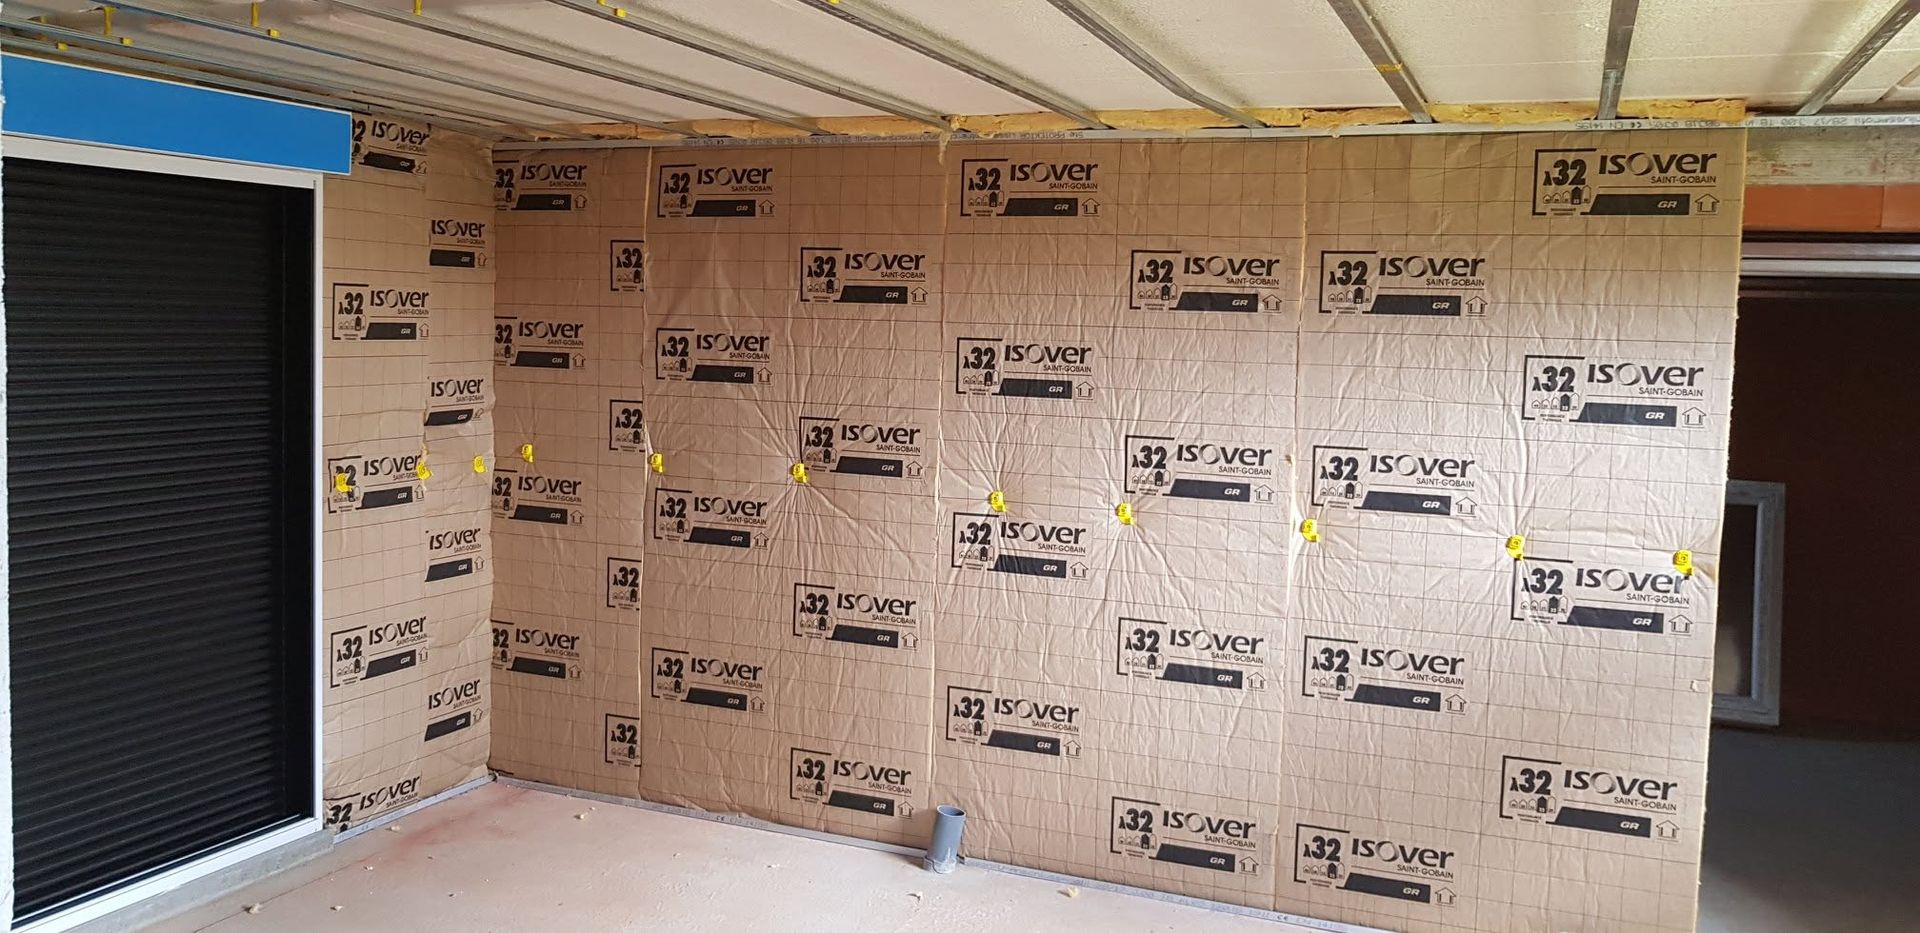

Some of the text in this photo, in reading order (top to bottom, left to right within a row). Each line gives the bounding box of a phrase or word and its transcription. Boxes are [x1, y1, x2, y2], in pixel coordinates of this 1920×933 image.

[495, 168, 514, 188] 32
[1651, 175, 1716, 184] SAINT-GOBAIN
[1657, 200, 1677, 208] GR
[1227, 277, 1279, 285] SAINT-GOBAIN
[1426, 278, 1485, 286] SAINT-GOBAIN
[1432, 302, 1449, 310] GR
[1043, 365, 1091, 373] SAINT-GOBAIN
[1639, 387, 1703, 397] SAINT-GOBAIN
[1645, 411, 1664, 420] GR
[877, 445, 920, 453] SAINT-GOBAIN
[1219, 466, 1271, 475] SAINT-GOBAIN
[1417, 477, 1475, 487] SAINT-GOBAIN
[1422, 501, 1440, 509] GR
[1038, 543, 1085, 553] SAINT-GOBAIN
[1626, 593, 1690, 604] SAINT-GOBAIN
[872, 614, 916, 624] SAINT-GOBAIN
[1633, 617, 1652, 626] GR
[877, 634, 890, 642] GR
[1211, 653, 1263, 664] SAINT-GOBAIN
[723, 678, 762, 689] SAINT-GOBAIN
[1407, 673, 1464, 685] SAINT-GOBAIN
[1413, 696, 1430, 705] GR
[1032, 721, 1079, 732] SAINT-GOBAIN
[868, 782, 911, 794] SAINT-GOBAIN
[1614, 797, 1677, 811] SAINT-GOBAIN
[1620, 821, 1640, 830] GR
[1204, 835, 1256, 848] SAINT-GOBAIN
[1210, 856, 1225, 865] GR
[1397, 865, 1453, 880] SAINT-GOBAIN
[1403, 887, 1420, 897] GR
